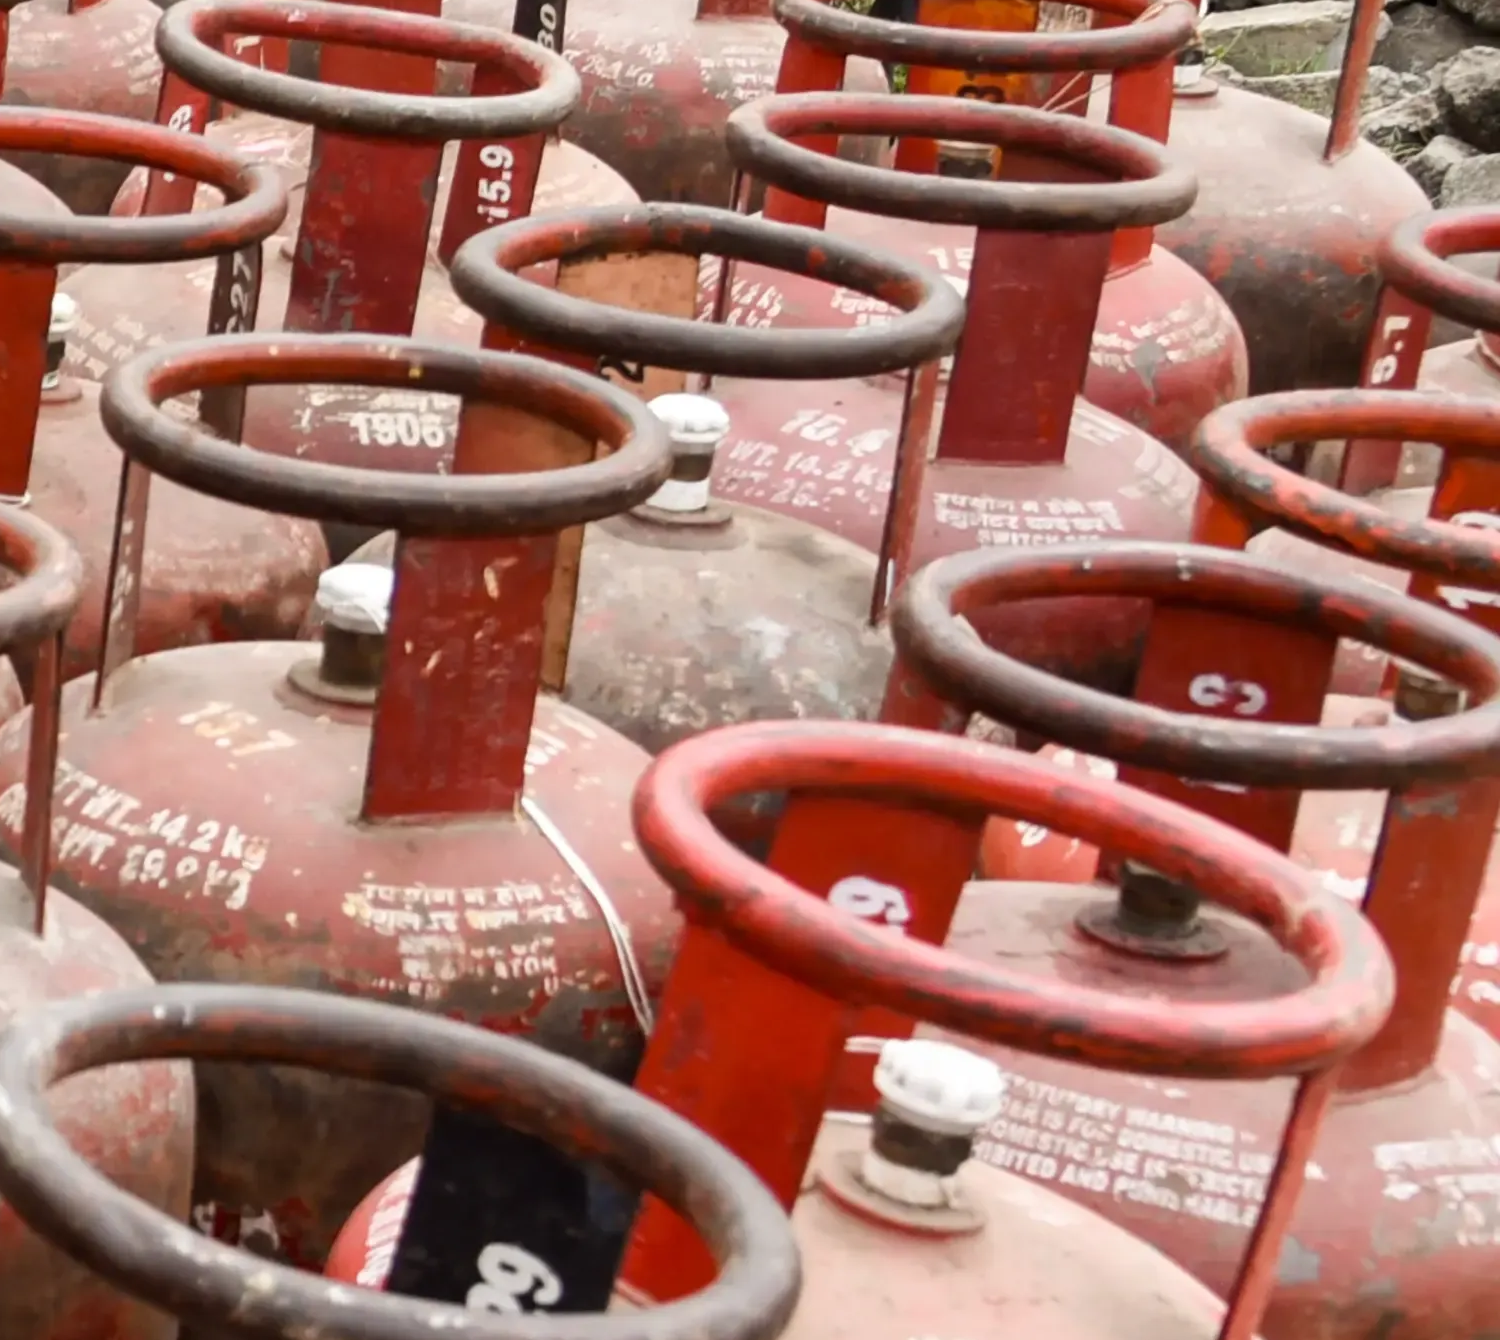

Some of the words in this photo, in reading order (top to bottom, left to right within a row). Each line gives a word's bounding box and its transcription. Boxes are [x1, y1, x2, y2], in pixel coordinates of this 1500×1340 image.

[476, 145, 514, 221] 15.9
[350, 412, 446, 448] 1906
[1059, 1162, 1110, 1193] AND
